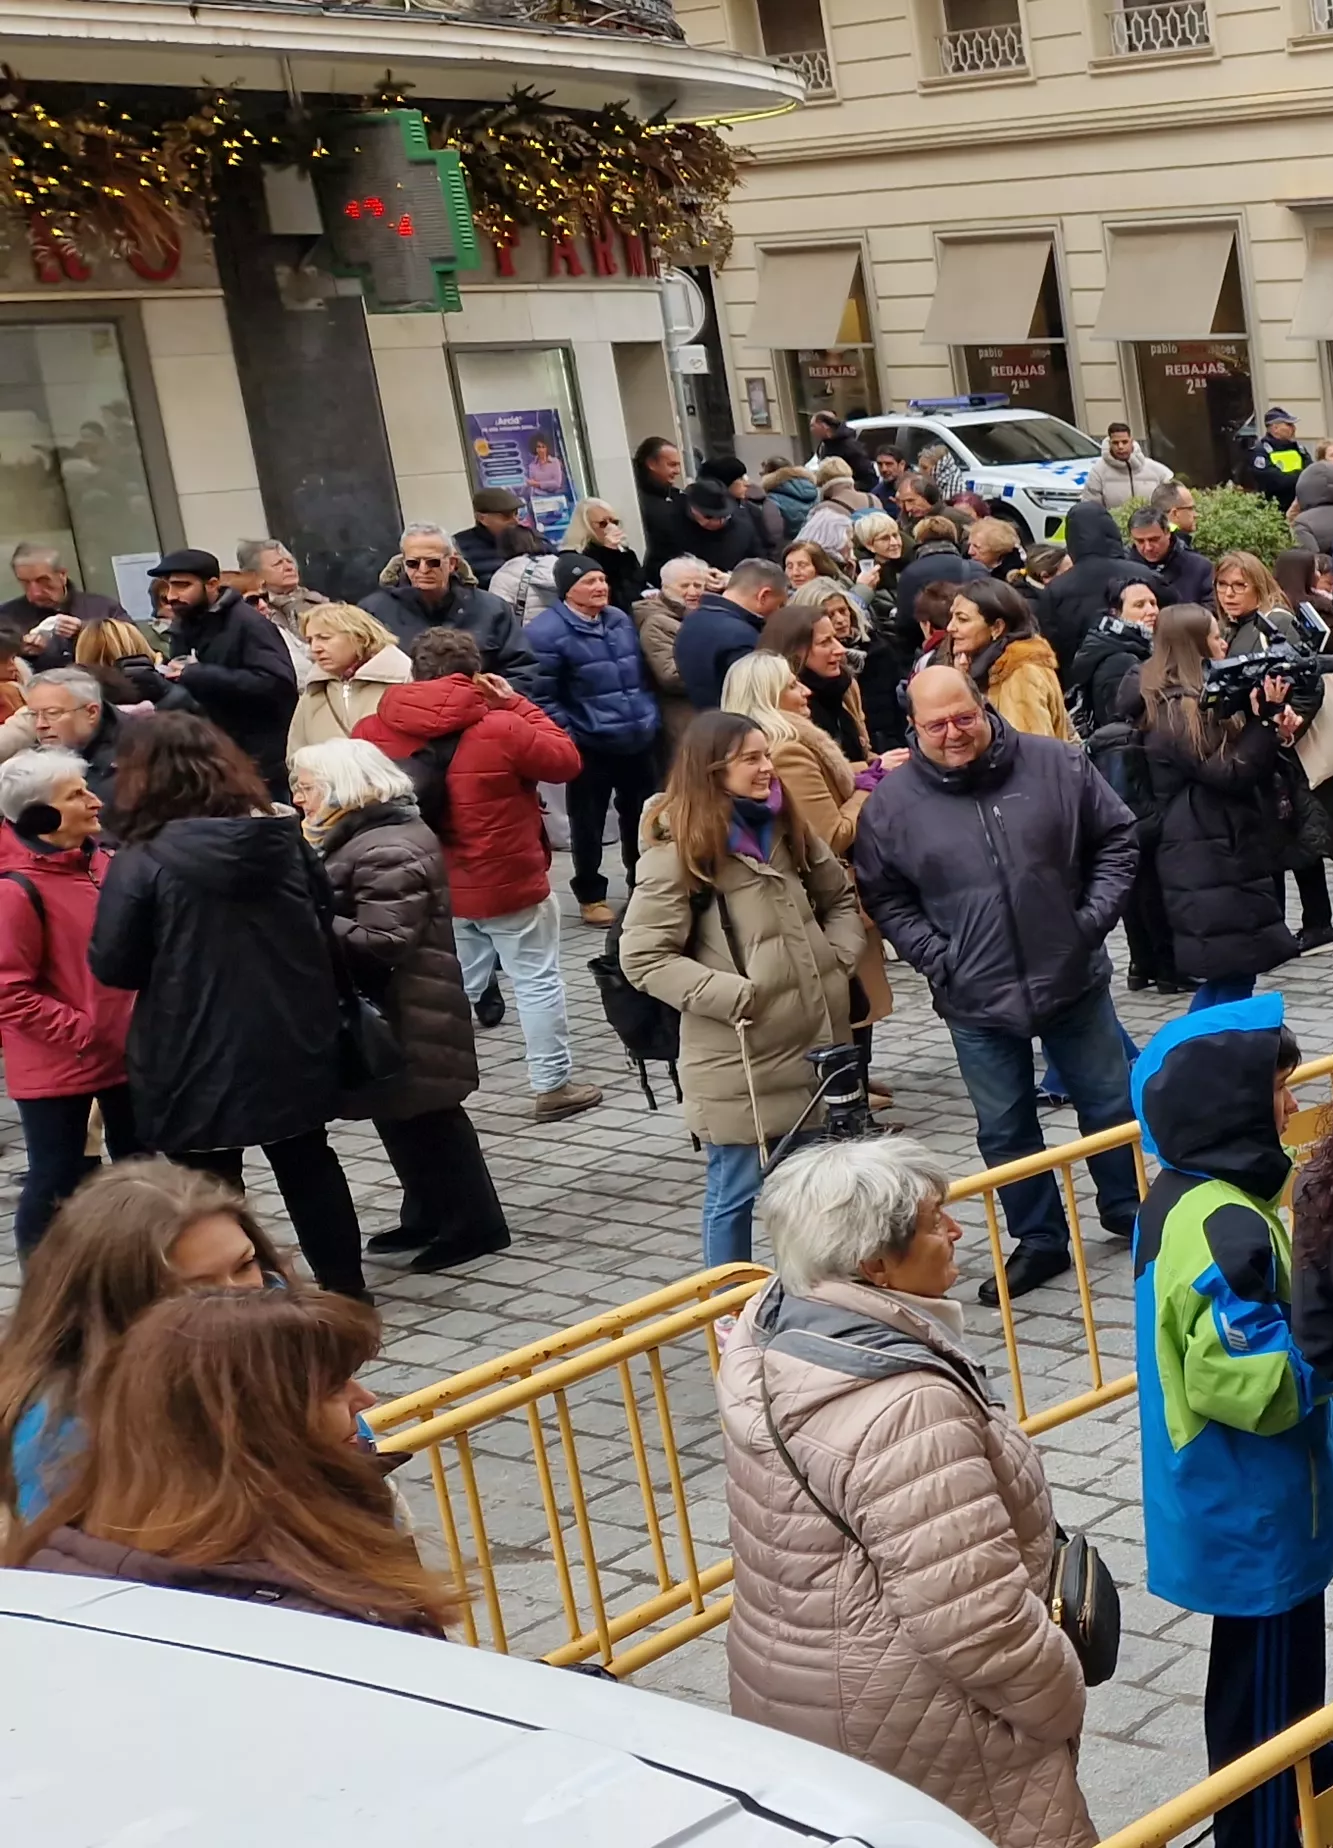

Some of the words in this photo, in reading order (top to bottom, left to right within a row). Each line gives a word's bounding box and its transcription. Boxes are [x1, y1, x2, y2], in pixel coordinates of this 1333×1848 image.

[978, 347, 1003, 360] pablo
[1150, 343, 1178, 356] pablo
[808, 366, 857, 377] REBAJAS
[991, 364, 1046, 377] REBAJAS
[1165, 362, 1226, 376] REBAJAS
